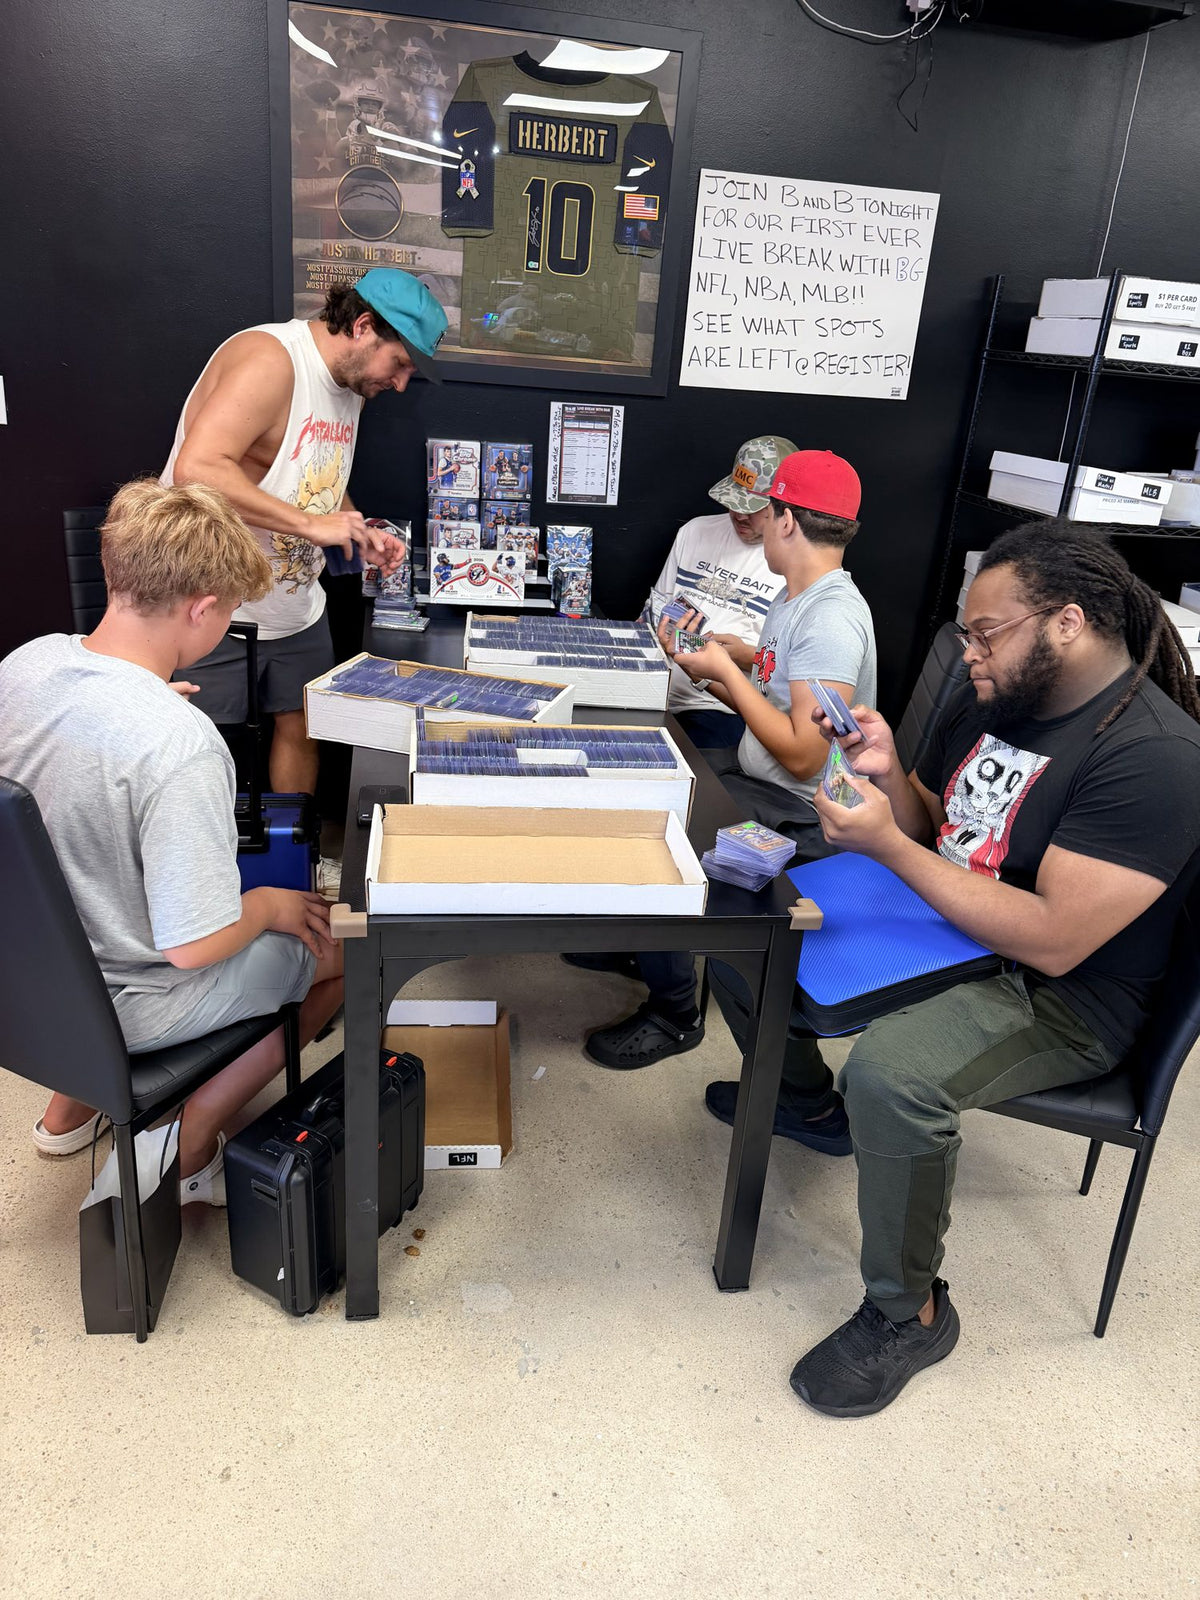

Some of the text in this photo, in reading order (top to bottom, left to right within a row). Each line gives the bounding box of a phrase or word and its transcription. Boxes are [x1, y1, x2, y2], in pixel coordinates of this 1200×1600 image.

[518, 119, 609, 158] HERBERT
[705, 175, 768, 201] JOIN
[857, 198, 934, 221] TONIGHT
[522, 176, 596, 278] 10
[703, 206, 921, 248] FOR OUR FIRST EVER
[307, 263, 324, 273] MOST
[698, 236, 924, 282] LIVE BREAK WITH BG
[306, 281, 323, 290] MOST
[310, 273, 327, 281] MOST
[338, 274, 361, 284] PASSE
[696, 272, 864, 306] NFL, NBA, MLB!!
[1180, 295, 1198, 303] CARD
[693, 311, 884, 338] SEE WHAT SPOTS
[688, 346, 731, 368] ARE
[738, 346, 797, 370] LEFT
[814, 351, 911, 377] REGISTER!
[290, 411, 355, 461] METALLIC
[734, 468, 754, 485] LMC
[740, 577, 774, 594] BAIT
[452, 1154, 475, 1163] NFL
